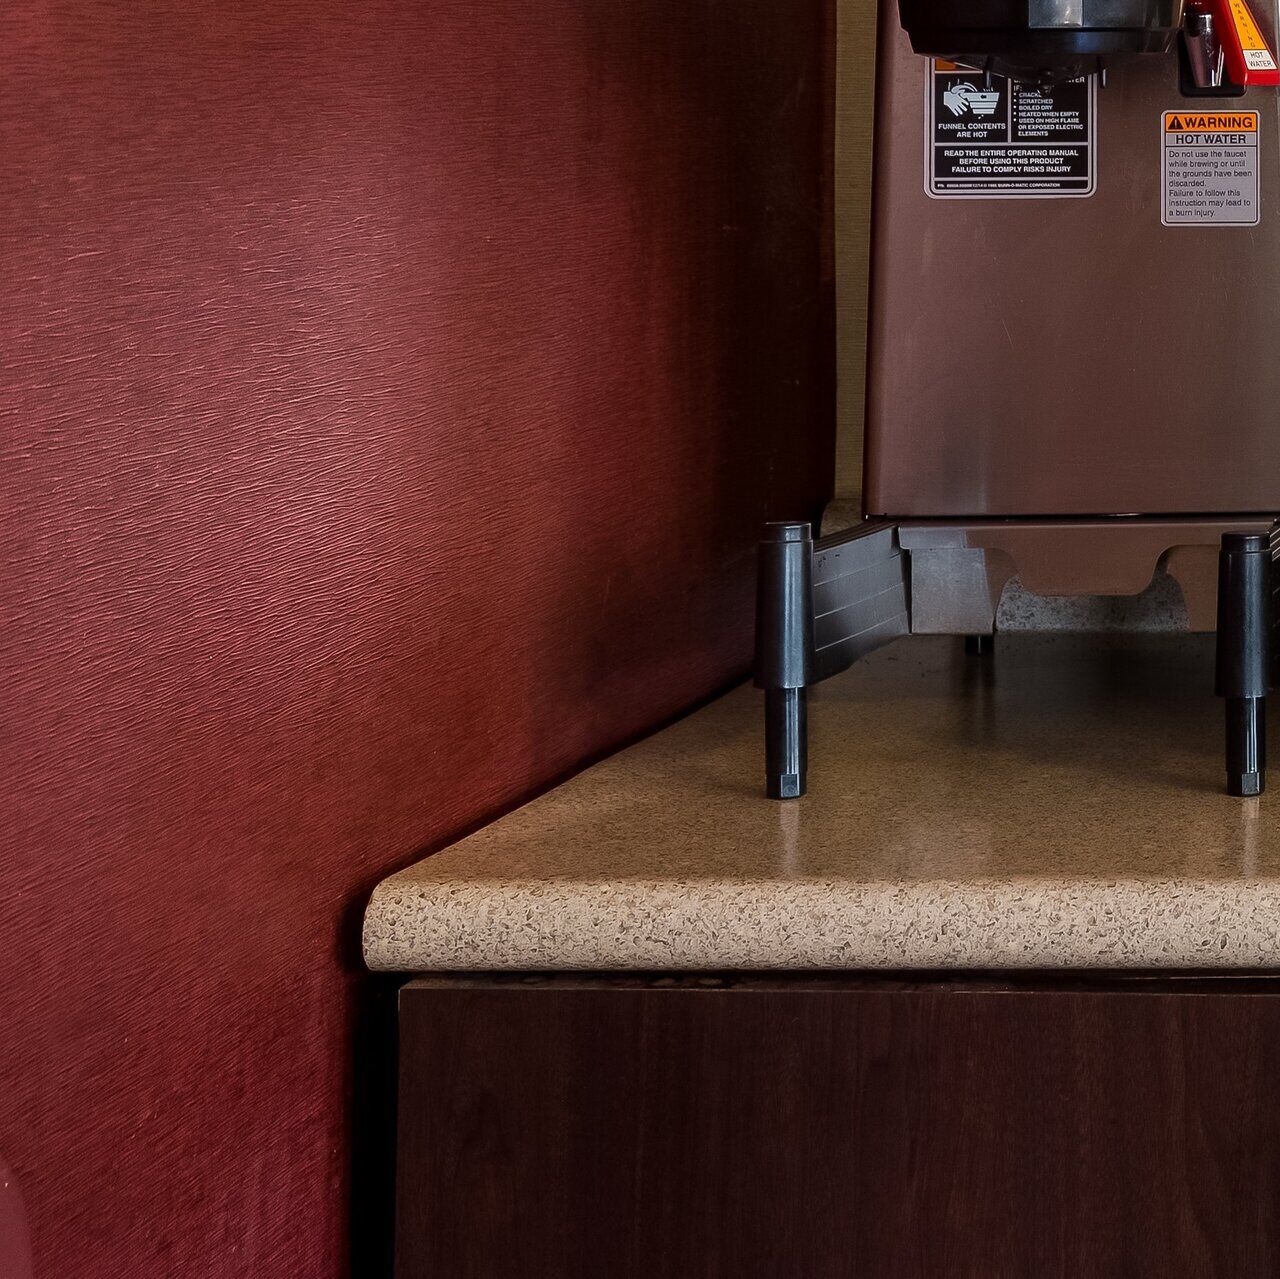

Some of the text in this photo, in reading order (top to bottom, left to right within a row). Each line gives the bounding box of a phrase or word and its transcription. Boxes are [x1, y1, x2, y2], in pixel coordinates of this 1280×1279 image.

[1233, 3, 1256, 48] WARNING
[1249, 51, 1264, 59] HOT
[1249, 60, 1273, 68] WATER
[1184, 117, 1253, 128] WARNING
[1175, 134, 1247, 145] HOT WATER
[1169, 160, 1188, 168] while
[1189, 160, 1218, 169] brewing
[1229, 160, 1245, 168] until
[1182, 170, 1212, 179] grounds
[1233, 169, 1253, 177] been
[1168, 180, 1207, 188] discarded.
[1227, 189, 1241, 197] this
[1168, 199, 1207, 207] instruction
[1175, 209, 1193, 217] burn
